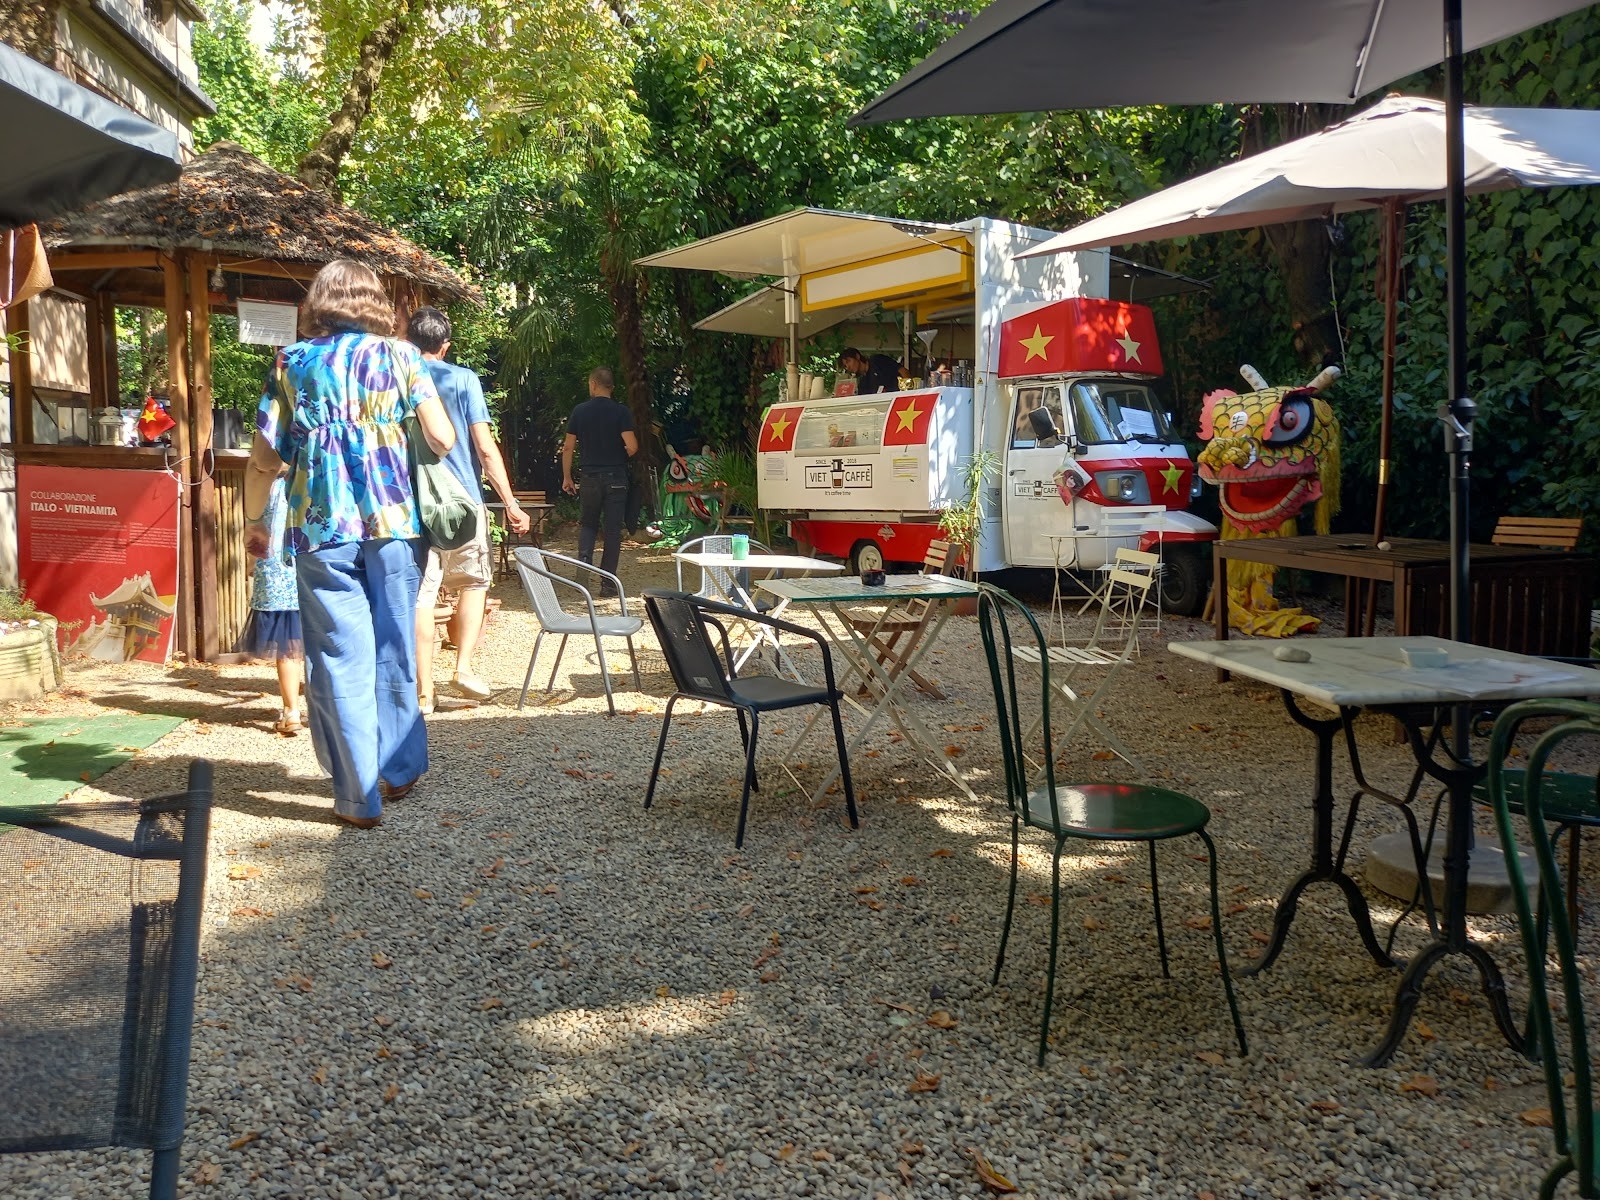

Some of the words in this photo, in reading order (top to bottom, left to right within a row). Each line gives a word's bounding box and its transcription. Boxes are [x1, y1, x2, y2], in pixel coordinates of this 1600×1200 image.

[810, 472, 827, 482] VIET
[845, 468, 871, 481] CAFFÈ
[31, 491, 97, 502] COLLABORAZIONE
[31, 502, 57, 513] ITALO
[65, 504, 118, 516] VIETNAMITA
